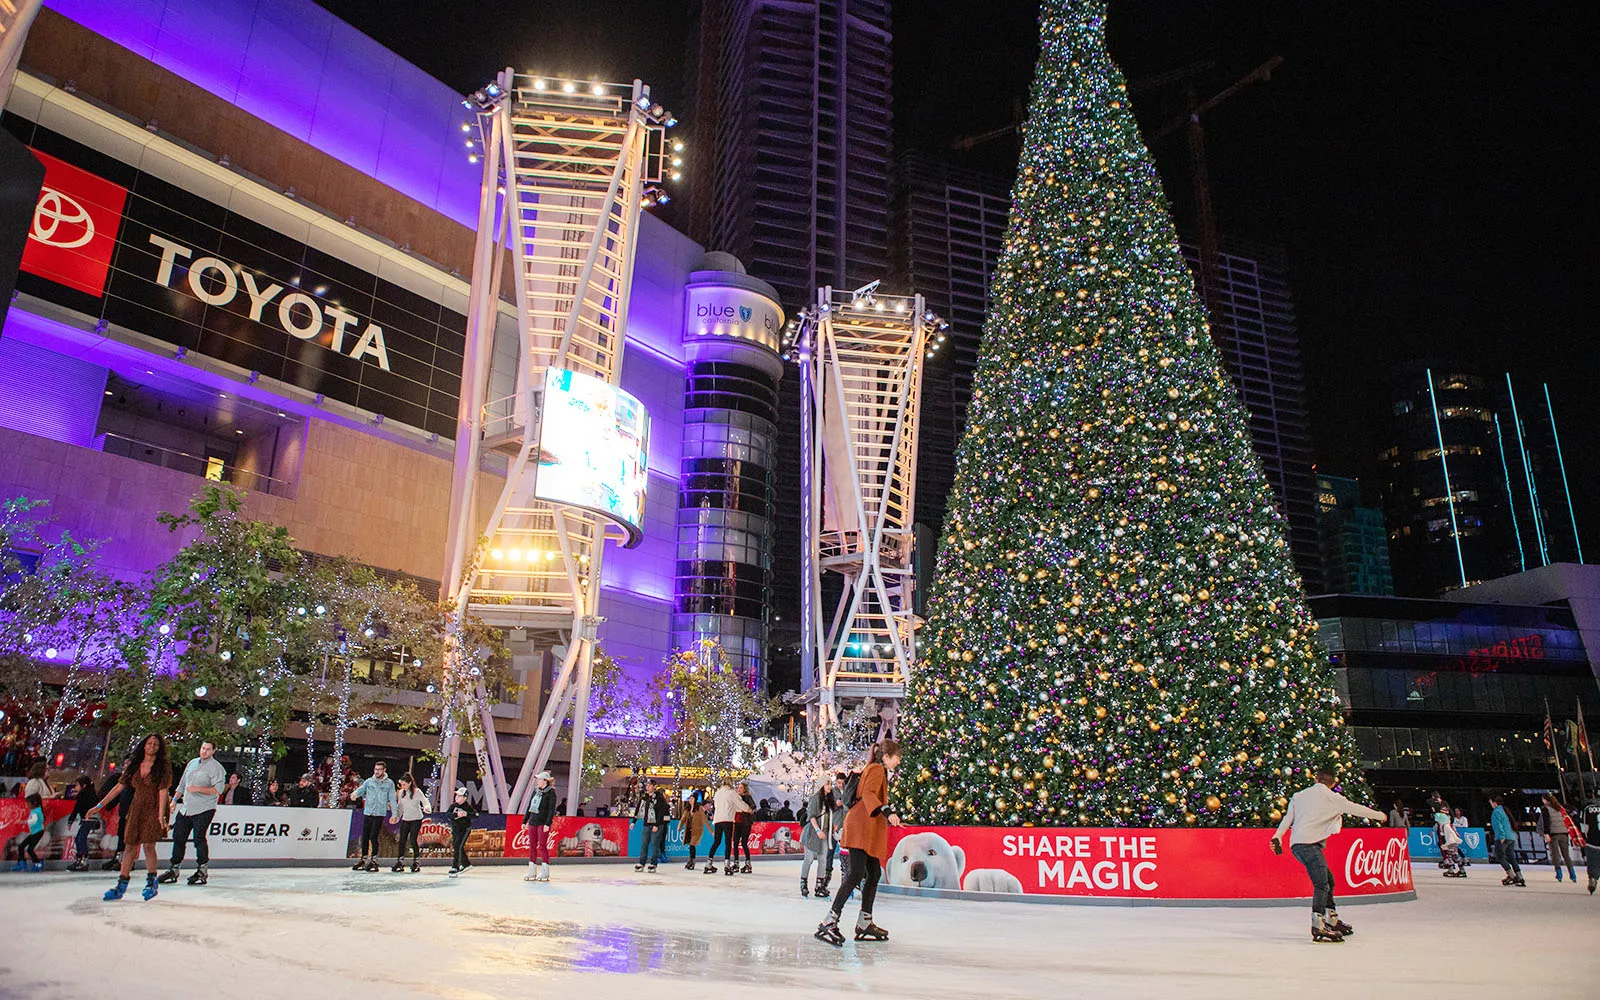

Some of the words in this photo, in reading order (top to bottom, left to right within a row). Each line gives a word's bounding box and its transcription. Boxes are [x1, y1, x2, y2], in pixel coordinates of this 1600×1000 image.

[149, 233, 391, 372] TOYOTA
[697, 303, 735, 317] blue
[702, 317, 740, 326] california
[209, 822, 239, 836] BIG
[243, 823, 290, 837] BEAR
[664, 825, 685, 843] lue
[1002, 835, 1091, 857] SHARE
[1100, 836, 1157, 858] THE
[1345, 838, 1409, 888] Coca-Cola
[1038, 860, 1159, 891] MAGIC
